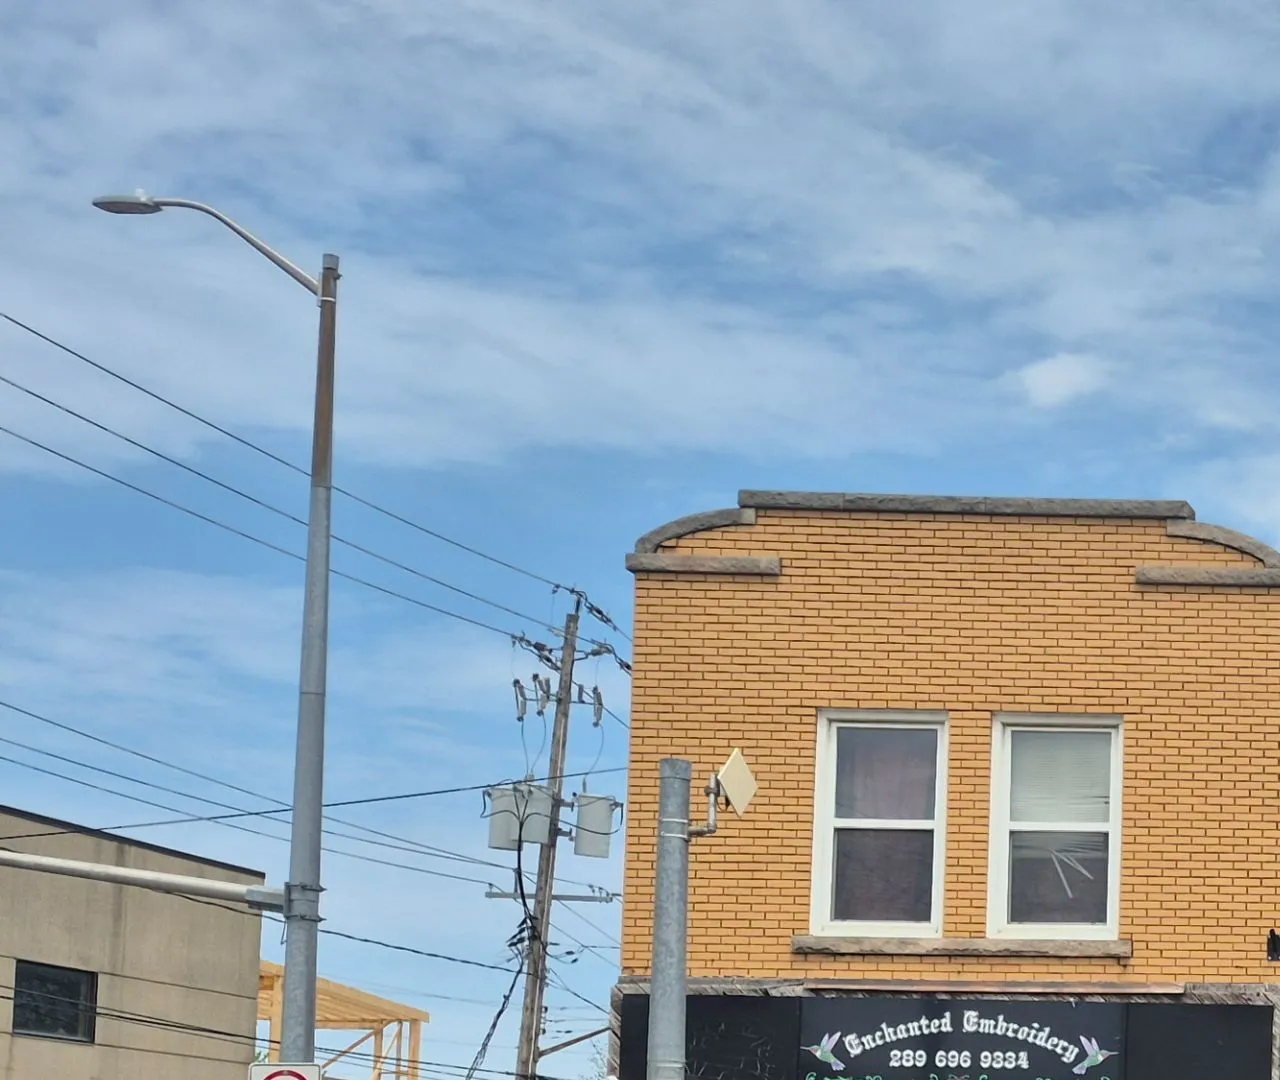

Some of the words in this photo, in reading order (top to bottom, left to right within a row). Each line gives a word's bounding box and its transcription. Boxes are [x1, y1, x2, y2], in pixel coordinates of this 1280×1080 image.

[842, 1011, 953, 1058] Enchanted
[962, 1010, 1080, 1063] Embroidery
[889, 1050, 926, 1068] 289
[935, 1051, 971, 1069] 696
